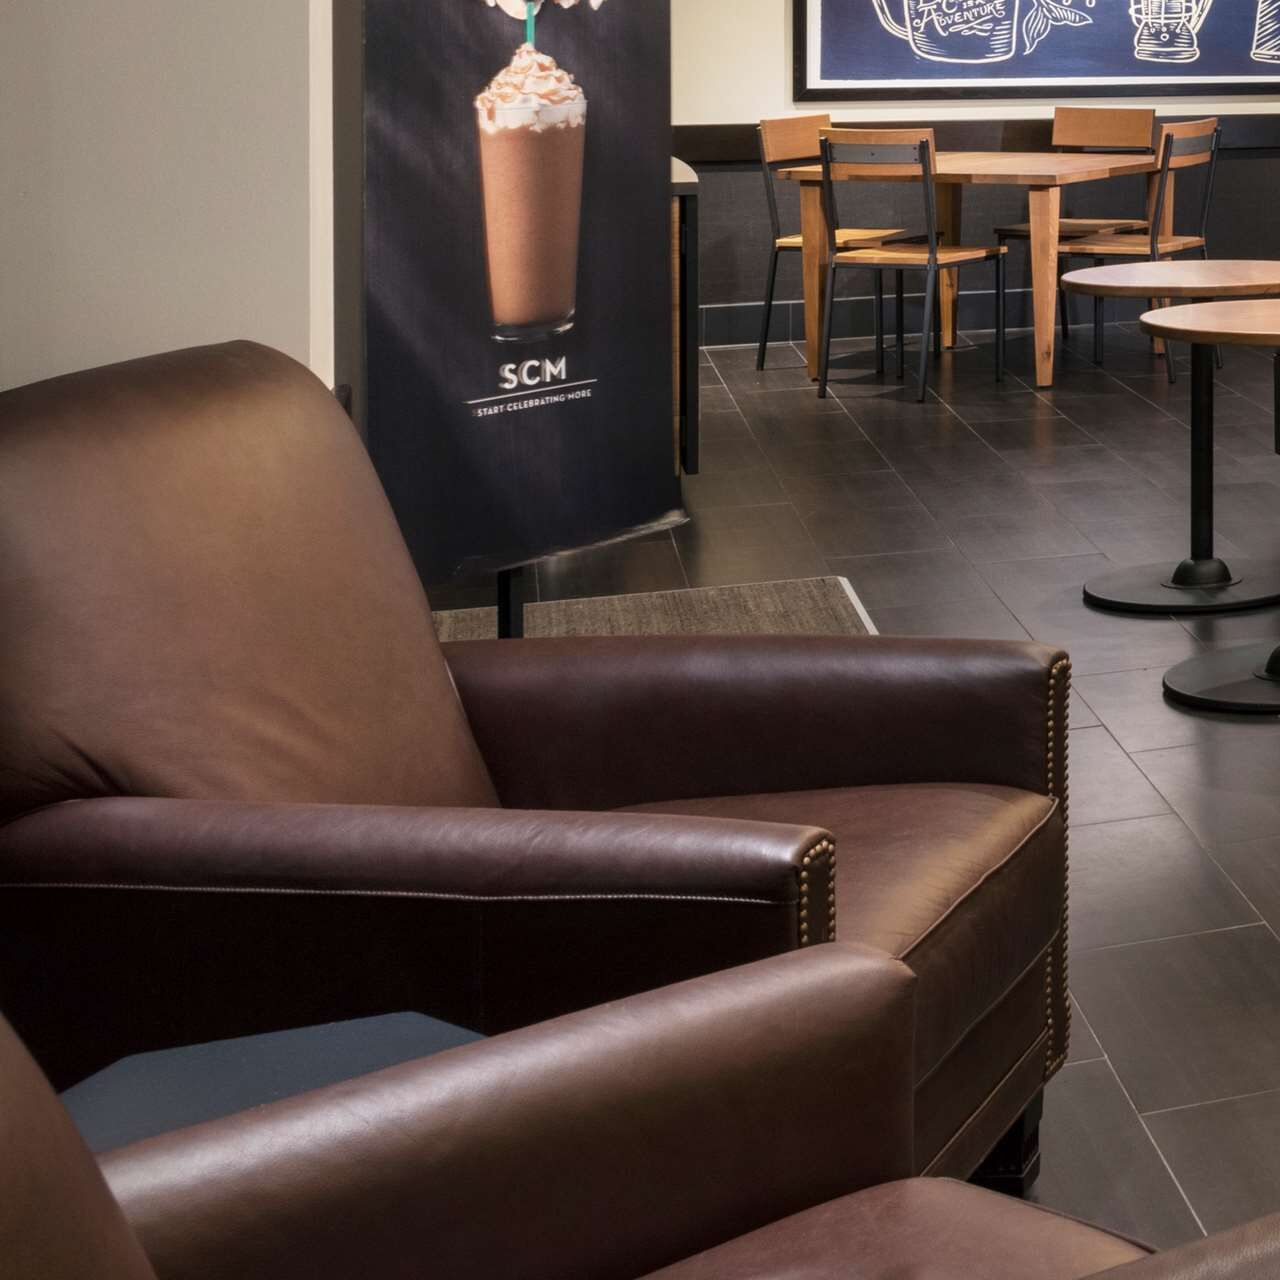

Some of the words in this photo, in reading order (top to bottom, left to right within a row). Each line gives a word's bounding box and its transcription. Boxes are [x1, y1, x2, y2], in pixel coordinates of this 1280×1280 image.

[498, 356, 567, 389] SCM
[477, 406, 504, 417] START
[506, 393, 565, 412] CELEBRATING
[567, 388, 592, 400] MORE
